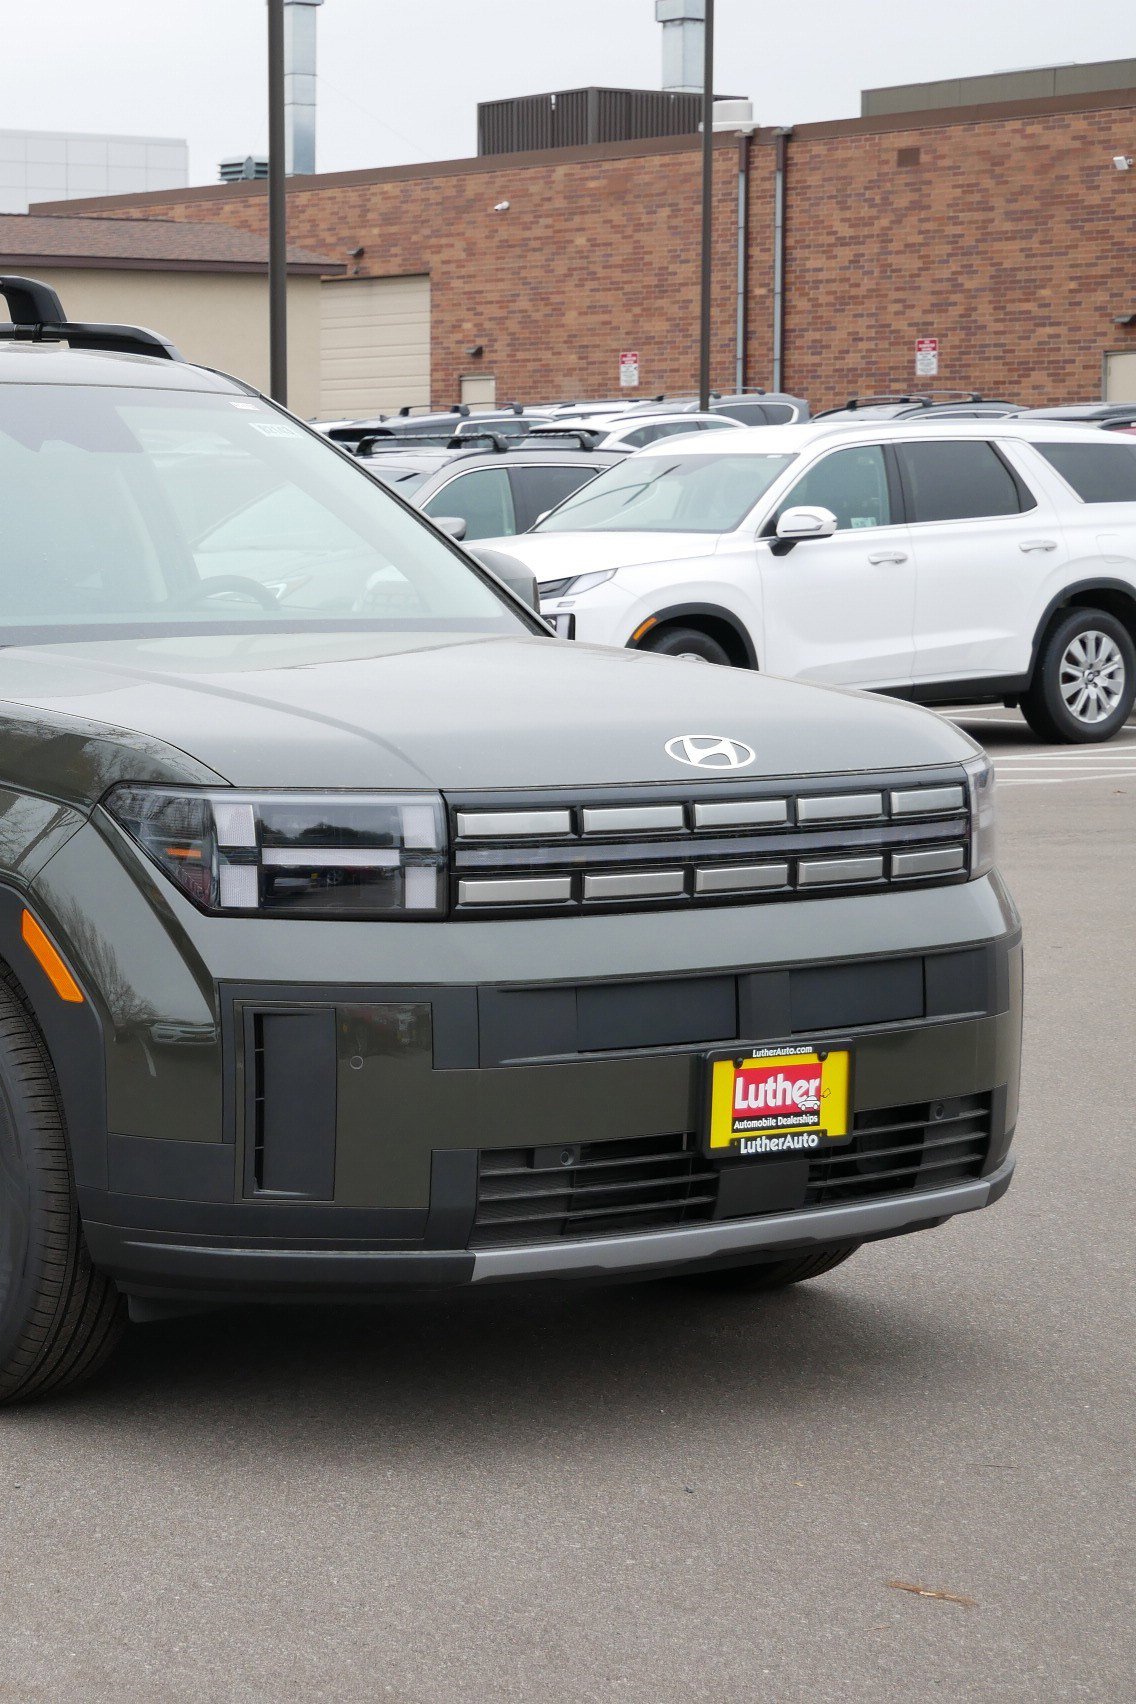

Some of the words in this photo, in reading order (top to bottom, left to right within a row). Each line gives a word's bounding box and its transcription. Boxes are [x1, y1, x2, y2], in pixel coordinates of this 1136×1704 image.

[752, 1046, 813, 1058] LutherAuto.com
[734, 1073, 820, 1110] Luther
[733, 1117, 776, 1130] Automobile
[777, 1114, 818, 1126] Dealerships
[740, 1133, 819, 1154] LutherAuto
